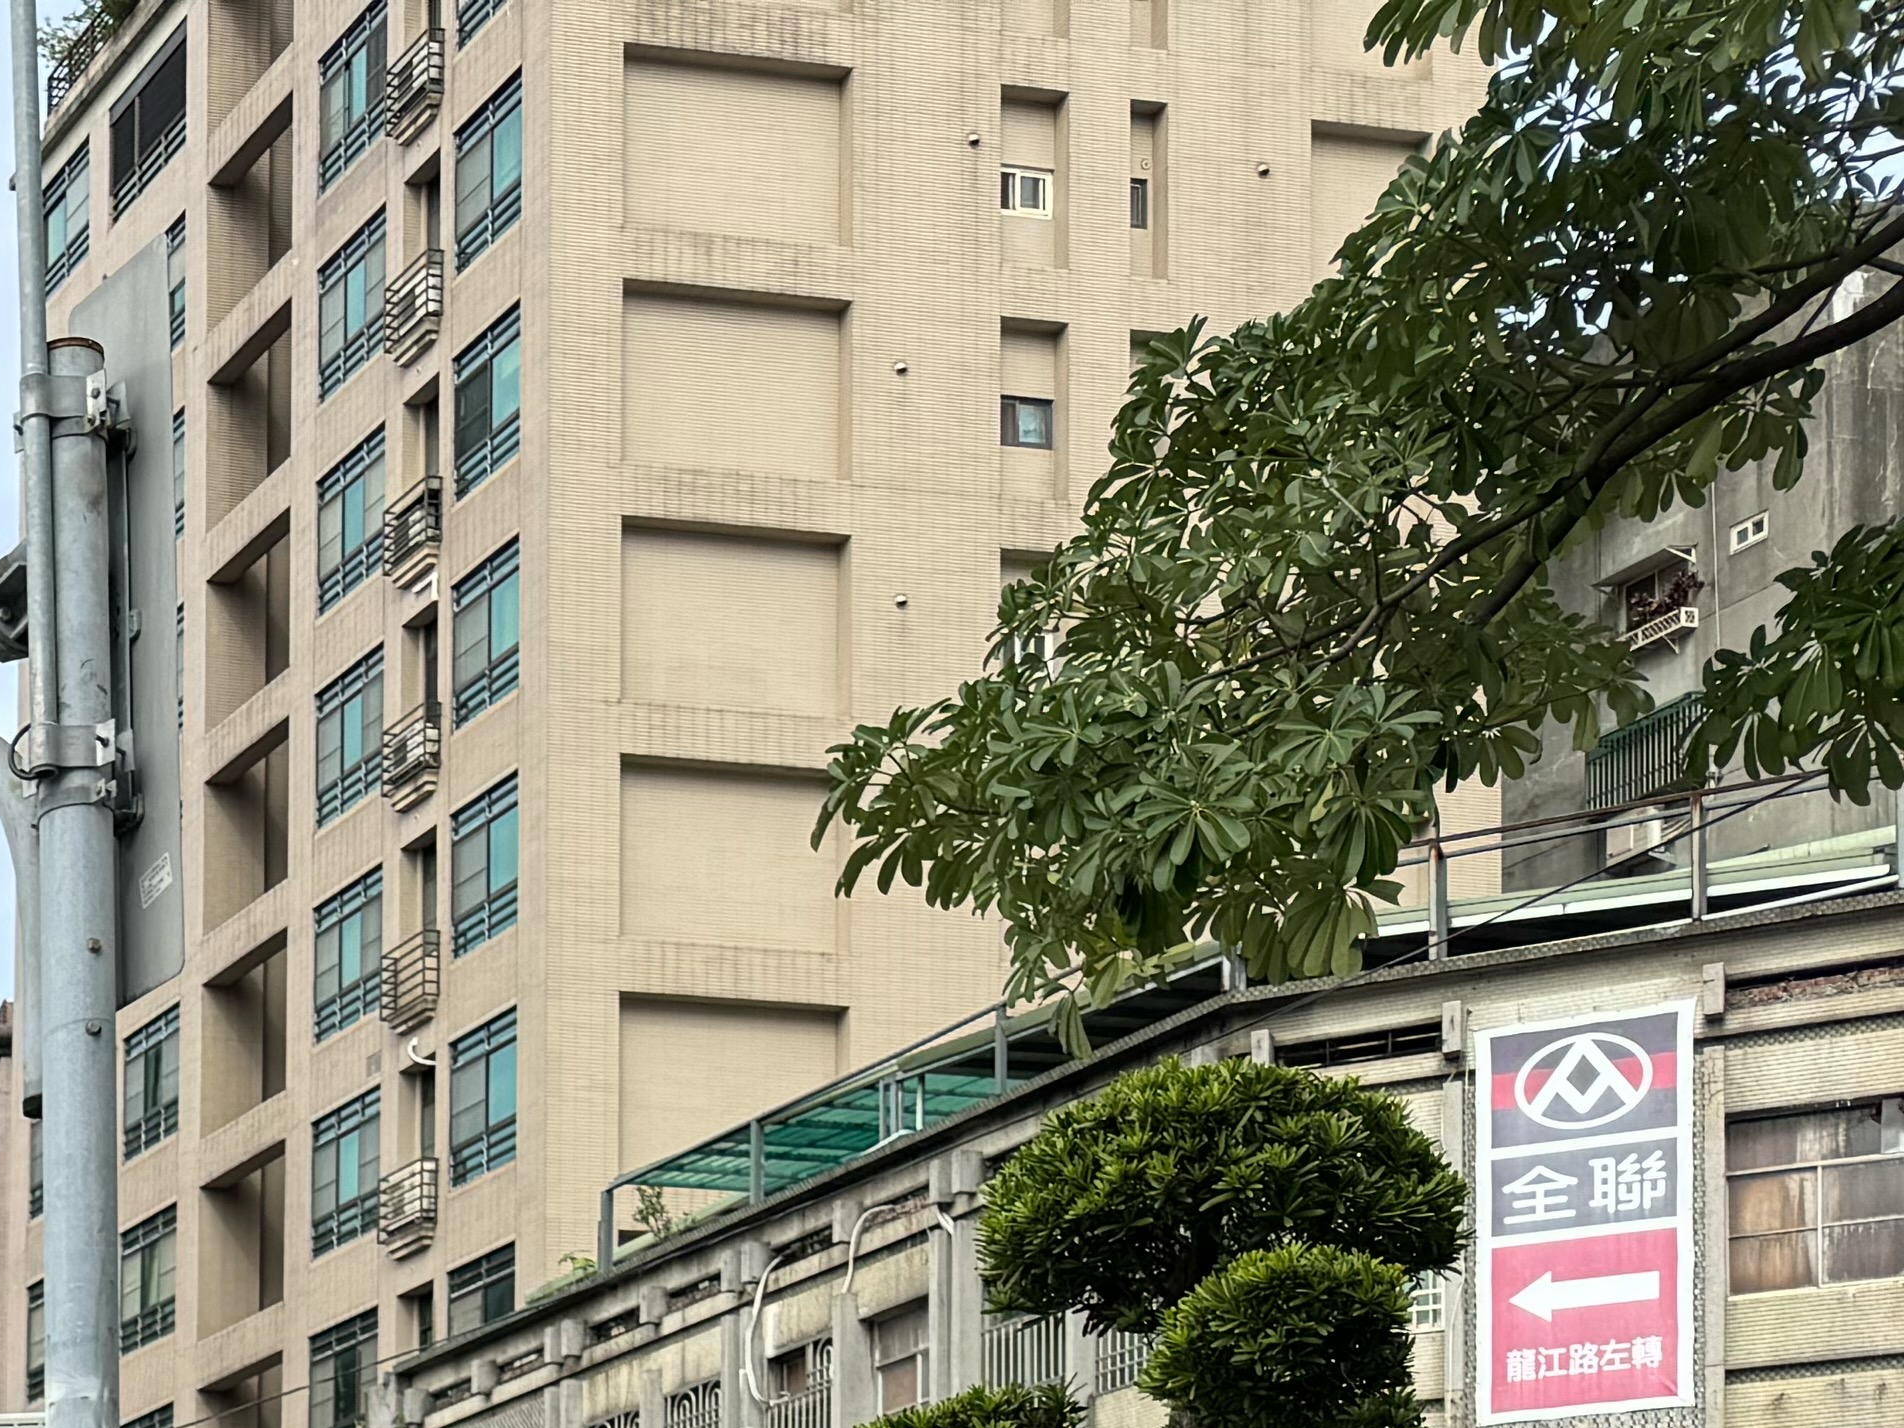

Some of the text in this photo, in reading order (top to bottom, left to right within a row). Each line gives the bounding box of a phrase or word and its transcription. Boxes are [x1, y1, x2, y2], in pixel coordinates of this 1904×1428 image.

[1501, 1148, 1668, 1225] 全聯
[1505, 1334, 1664, 1384] 龍江路左轉
